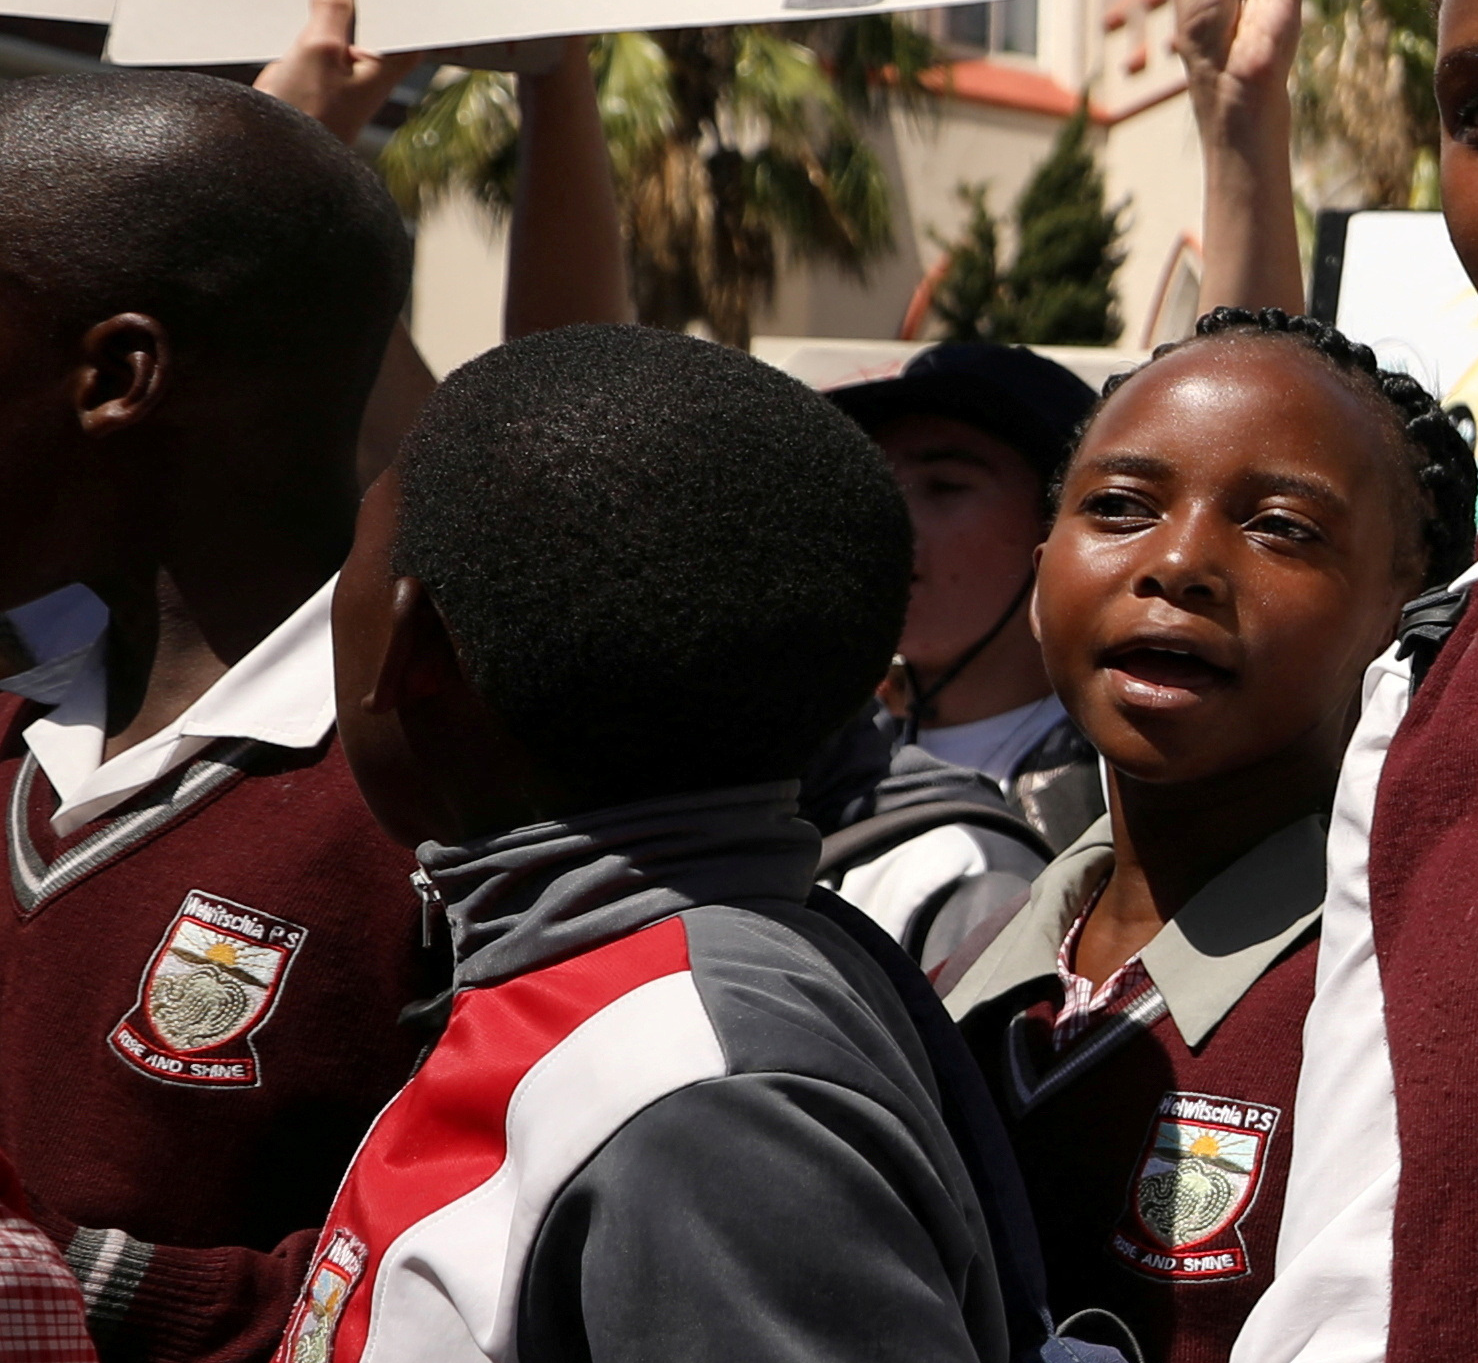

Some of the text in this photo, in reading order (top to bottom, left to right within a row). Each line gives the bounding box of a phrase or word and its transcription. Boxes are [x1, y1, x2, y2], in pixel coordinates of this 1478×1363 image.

[117, 1027, 247, 1079] RISE AND SHINE
[1140, 1252, 1177, 1271] AND
[1182, 1253, 1235, 1273] SHINE
